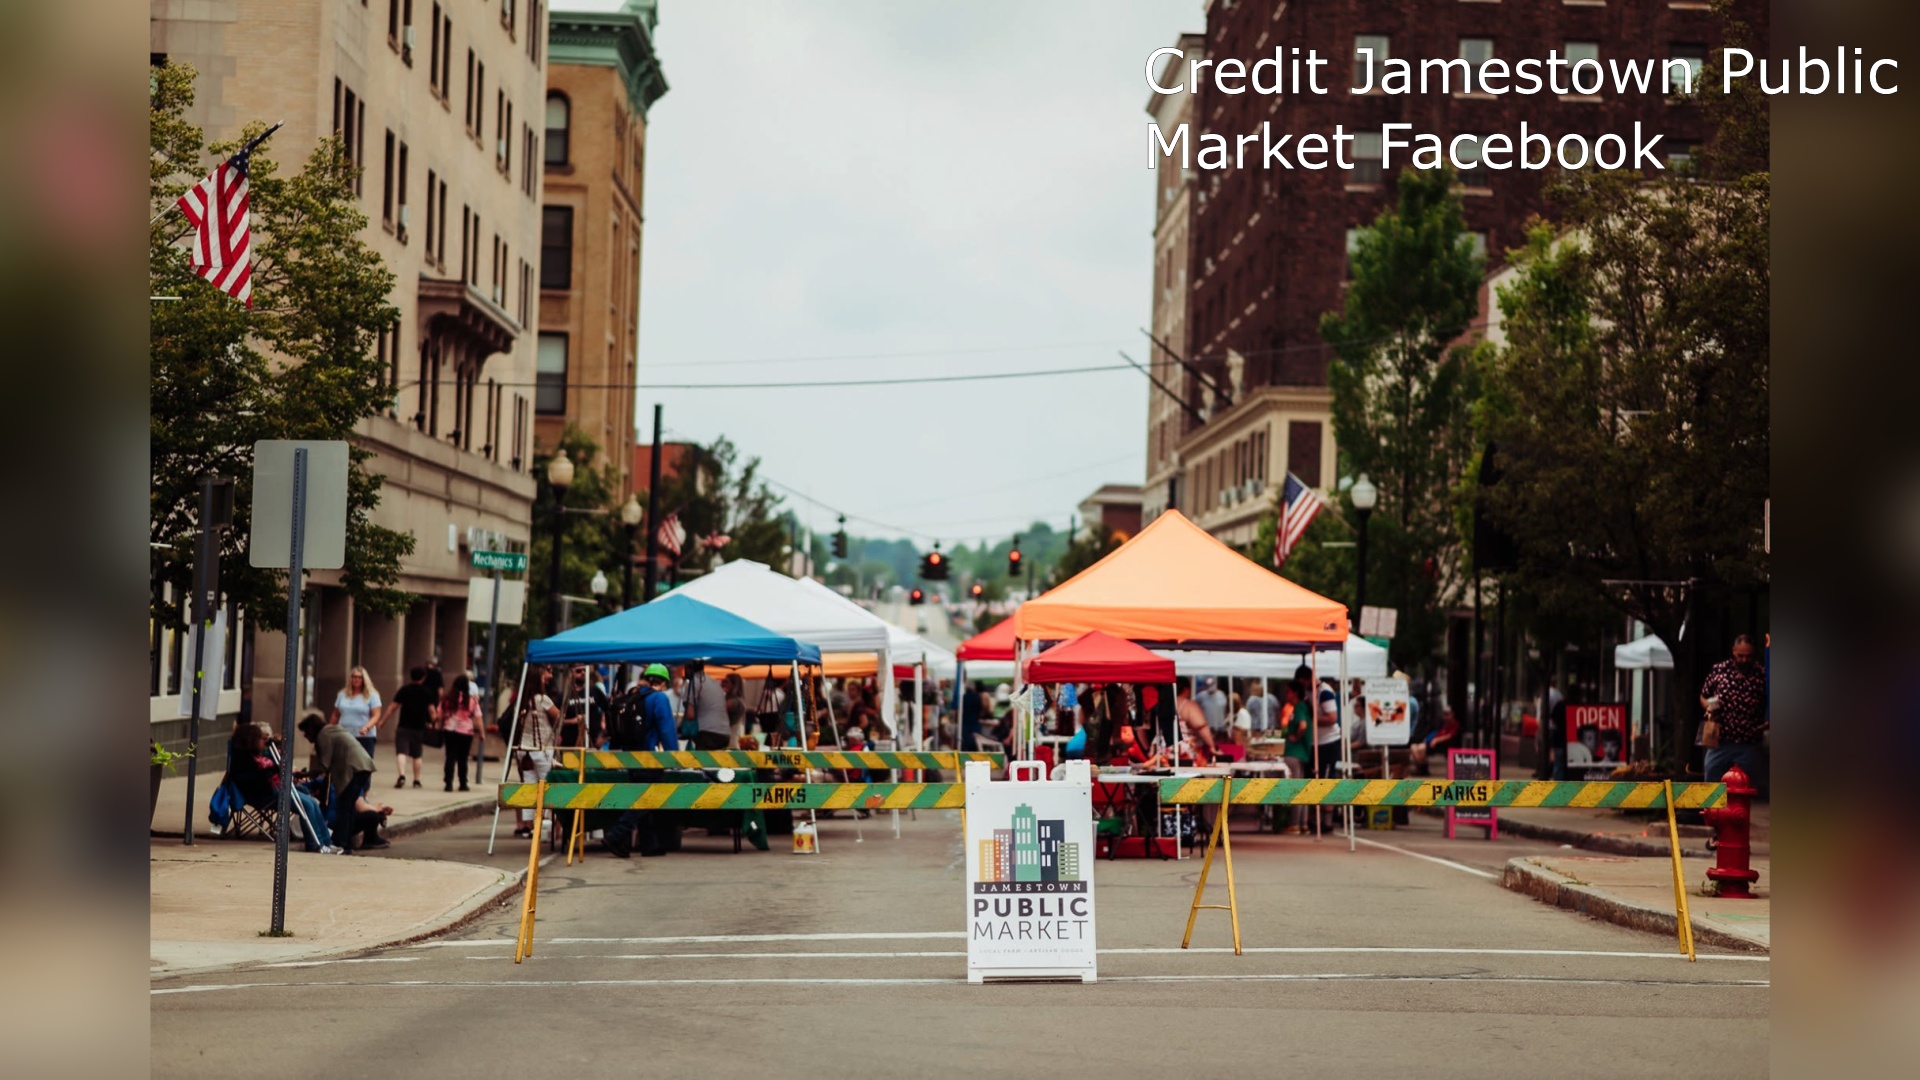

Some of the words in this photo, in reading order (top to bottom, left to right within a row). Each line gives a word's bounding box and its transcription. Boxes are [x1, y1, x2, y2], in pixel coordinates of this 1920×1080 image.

[473, 552, 513, 568] Mechanics
[1576, 706, 1619, 730] OPEN
[765, 754, 801, 765] PARKS
[752, 788, 806, 803] PARKS
[1432, 785, 1487, 802] PARKS
[980, 883, 1081, 892] JAMESTOWN
[974, 897, 1088, 917] PUBLIC
[974, 920, 1088, 940] MARKET
